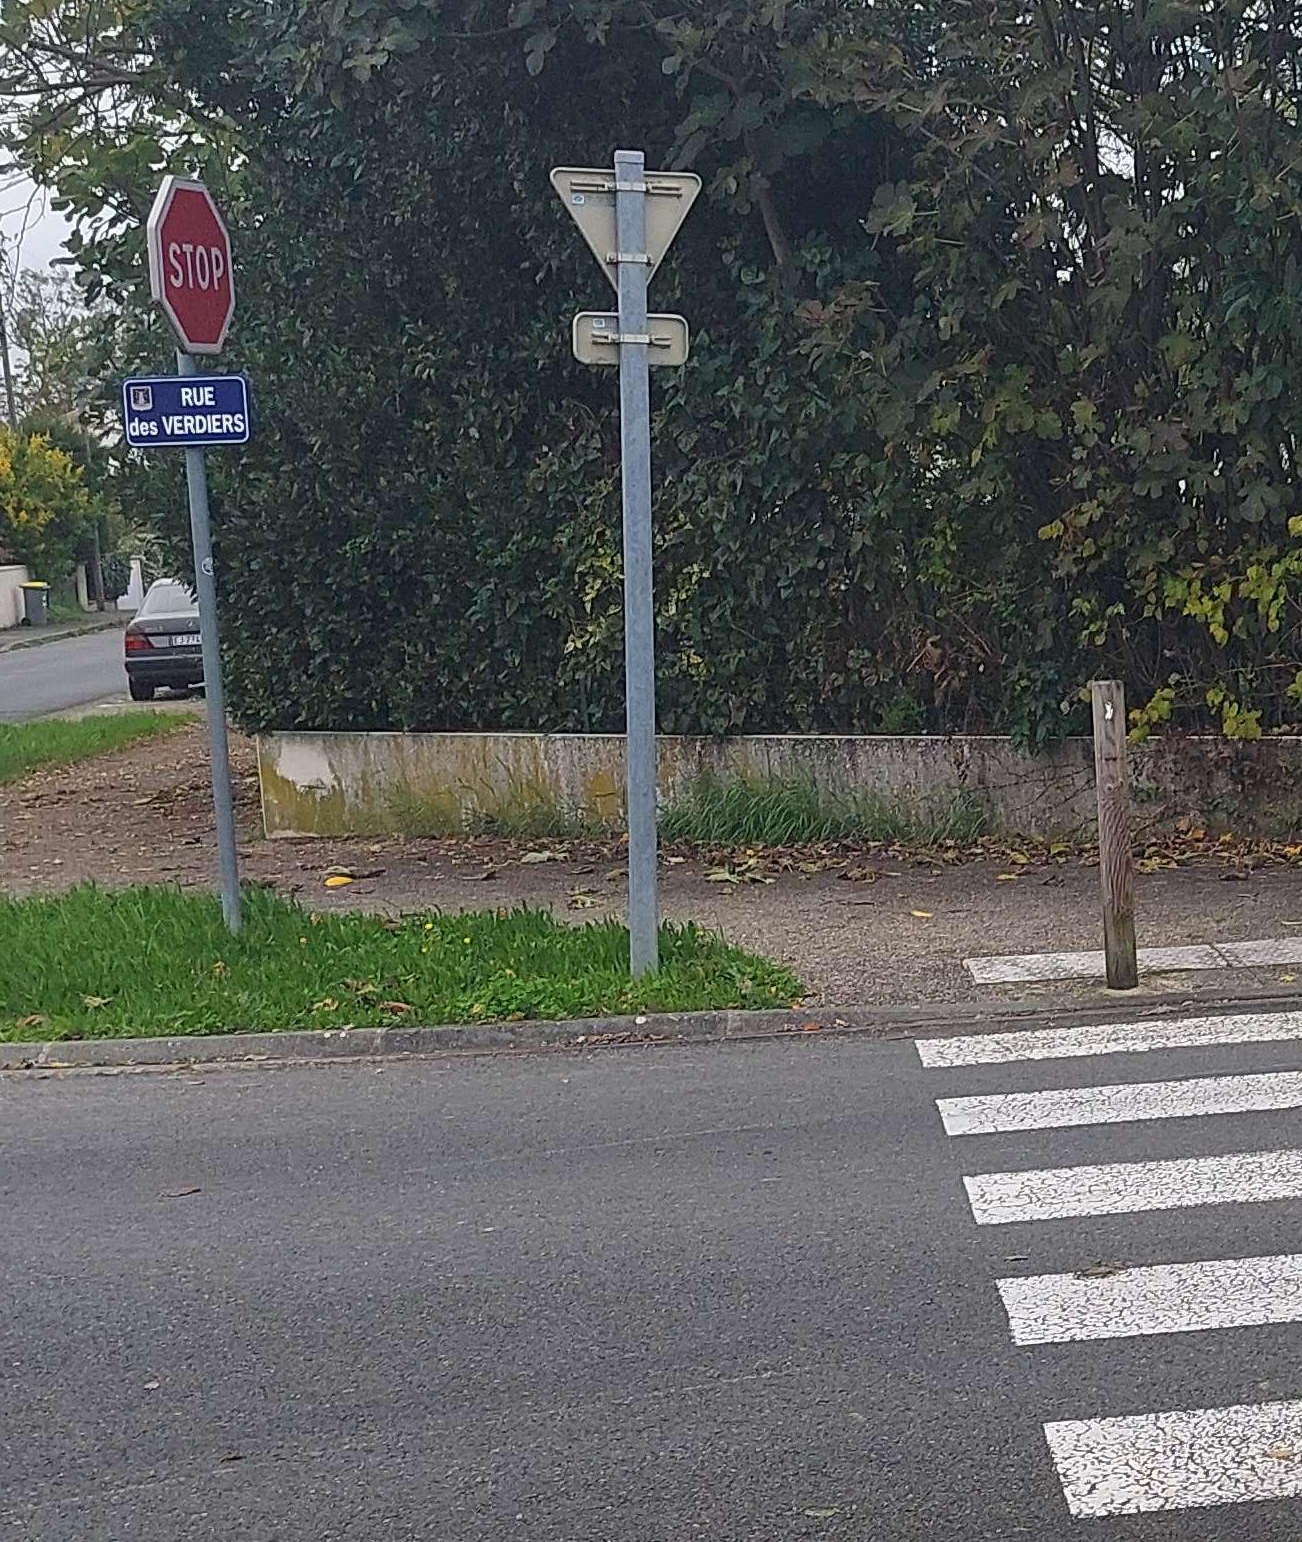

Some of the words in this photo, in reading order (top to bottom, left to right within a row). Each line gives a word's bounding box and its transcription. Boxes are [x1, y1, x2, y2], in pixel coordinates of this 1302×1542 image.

[169, 242, 224, 290] STOP
[181, 387, 215, 407] RUE
[129, 418, 158, 437] des
[161, 414, 245, 435] VERDIERS
